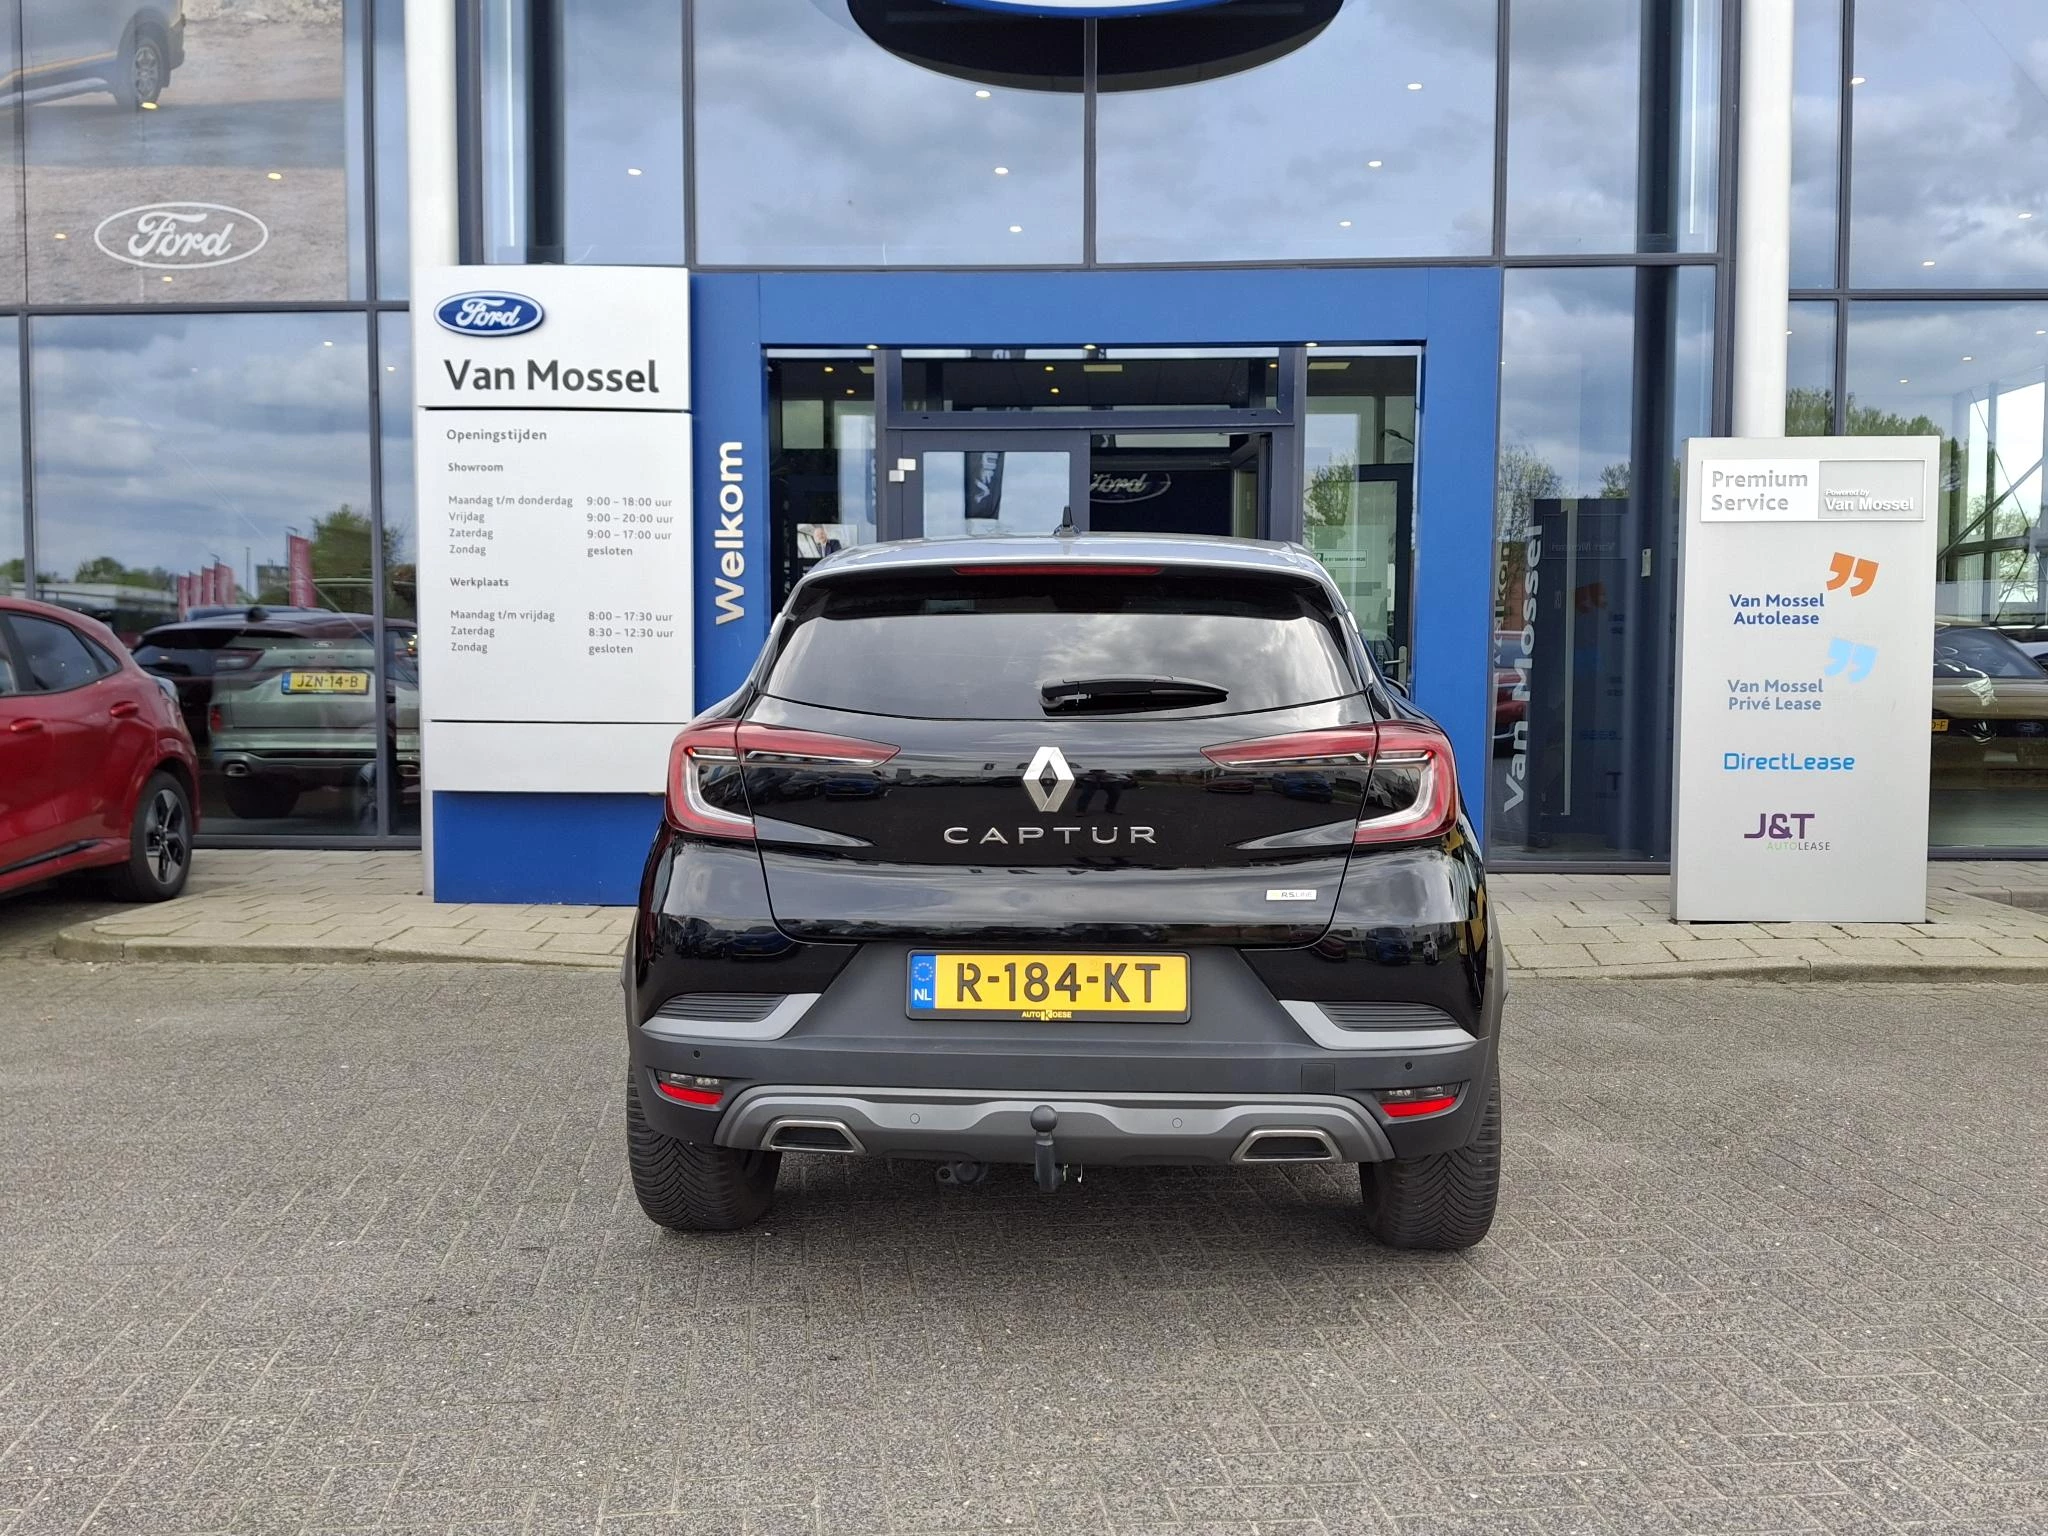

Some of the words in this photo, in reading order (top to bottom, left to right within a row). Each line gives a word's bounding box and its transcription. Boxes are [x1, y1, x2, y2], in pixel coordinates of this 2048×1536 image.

[128, 211, 235, 257] Ford
[455, 297, 522, 328] Ford
[444, 359, 515, 390] Van
[528, 359, 659, 393] Mossel
[446, 429, 548, 444] Openingstijden
[448, 462, 504, 473] Showroom
[1712, 470, 1808, 488] Premium
[448, 496, 494, 508] Maandag
[496, 496, 516, 505] t/m
[518, 496, 574, 508] donderdag
[586, 496, 611, 506] 9:00
[622, 497, 652, 507] 18:00
[655, 499, 673, 507] uur
[1712, 493, 1789, 511] Service
[1826, 498, 1854, 511] Van
[1859, 496, 1914, 511] Mossel
[448, 511, 486, 524] Vrijdag
[586, 513, 611, 523] 9:00
[622, 513, 654, 524] 20:00
[656, 516, 674, 524] uur
[449, 528, 494, 541] Zaterdag
[586, 529, 611, 539] 9:00
[623, 530, 652, 540] 17:00
[654, 532, 672, 540] uur
[714, 441, 745, 625] Welkom
[449, 544, 487, 557] Zondag
[587, 546, 633, 558] gesloten
[450, 576, 510, 589] Werkplaats
[1729, 594, 1760, 608] Van
[1765, 593, 1825, 607] Mossel
[450, 610, 496, 622] Maandag
[497, 610, 517, 620] t/m
[519, 610, 556, 623] vrijdag
[588, 611, 613, 621] 8:00
[624, 611, 653, 622] 17:30
[655, 614, 673, 622] uur
[1511, 524, 1543, 702] Mossel
[1733, 611, 1820, 625] Autolease
[450, 626, 496, 638] Zaterdag
[588, 627, 613, 637] 8:30
[624, 628, 654, 638] 12:30
[656, 630, 674, 638] uur
[451, 642, 488, 655] Zondag
[588, 643, 634, 656] gesloten
[1728, 679, 1760, 693] Van
[1764, 678, 1824, 693] Mossel
[1728, 696, 1771, 710] Privé
[1776, 697, 1822, 710] Lease
[1504, 720, 1528, 813] Van
[1724, 753, 1855, 770] DirectLease
[1744, 813, 1816, 840] J&T
[943, 826, 1158, 845] CAPTUR
[956, 962, 1161, 1003] R-184-KT
[914, 989, 932, 1001] NL
